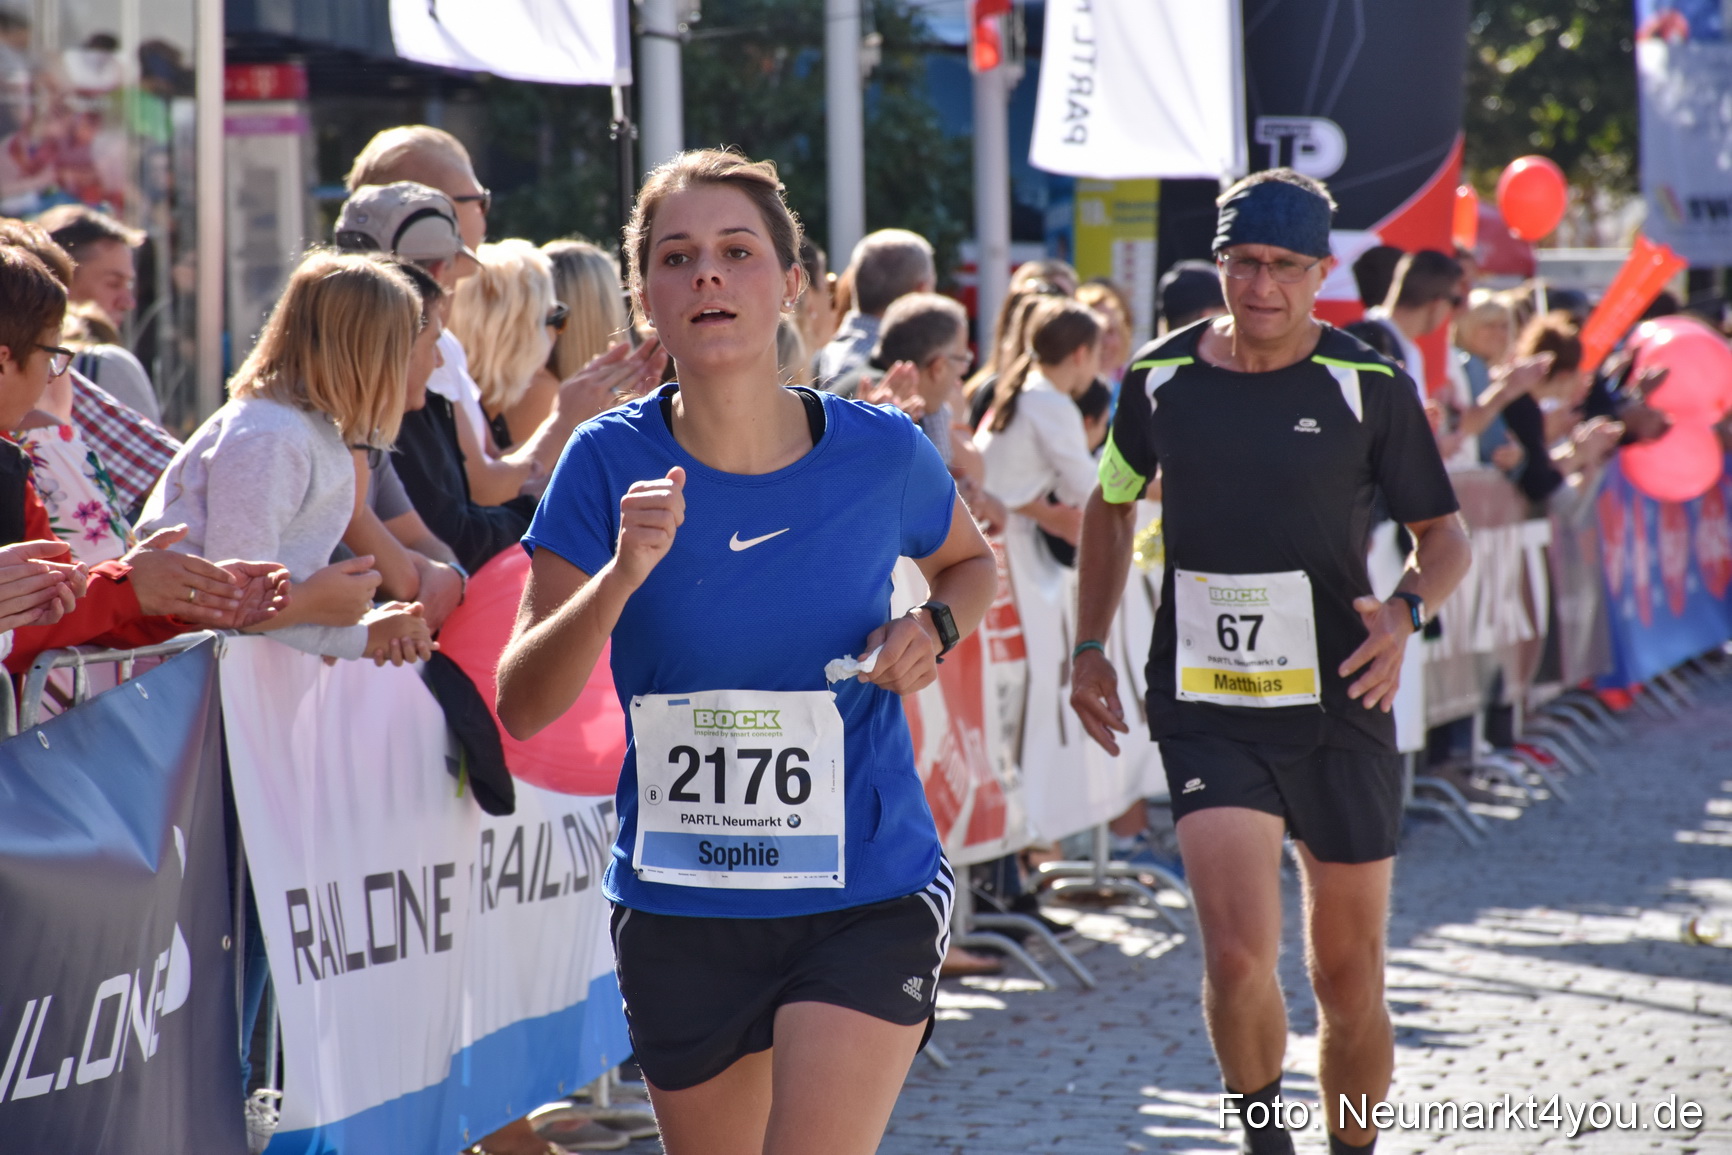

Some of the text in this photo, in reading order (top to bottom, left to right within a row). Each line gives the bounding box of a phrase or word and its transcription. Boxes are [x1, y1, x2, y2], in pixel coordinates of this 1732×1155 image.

[1208, 587, 1269, 602] BOCK
[1217, 613, 1264, 652] 67
[1208, 656, 1232, 665] PARTL
[1213, 673, 1283, 693] Matthias
[693, 709, 782, 730] BOCK
[694, 729, 720, 737] inspired
[720, 730, 729, 738] by
[668, 745, 812, 805] 2176
[680, 813, 782, 827] PARTL Neumarkt
[698, 840, 779, 871] Sophie
